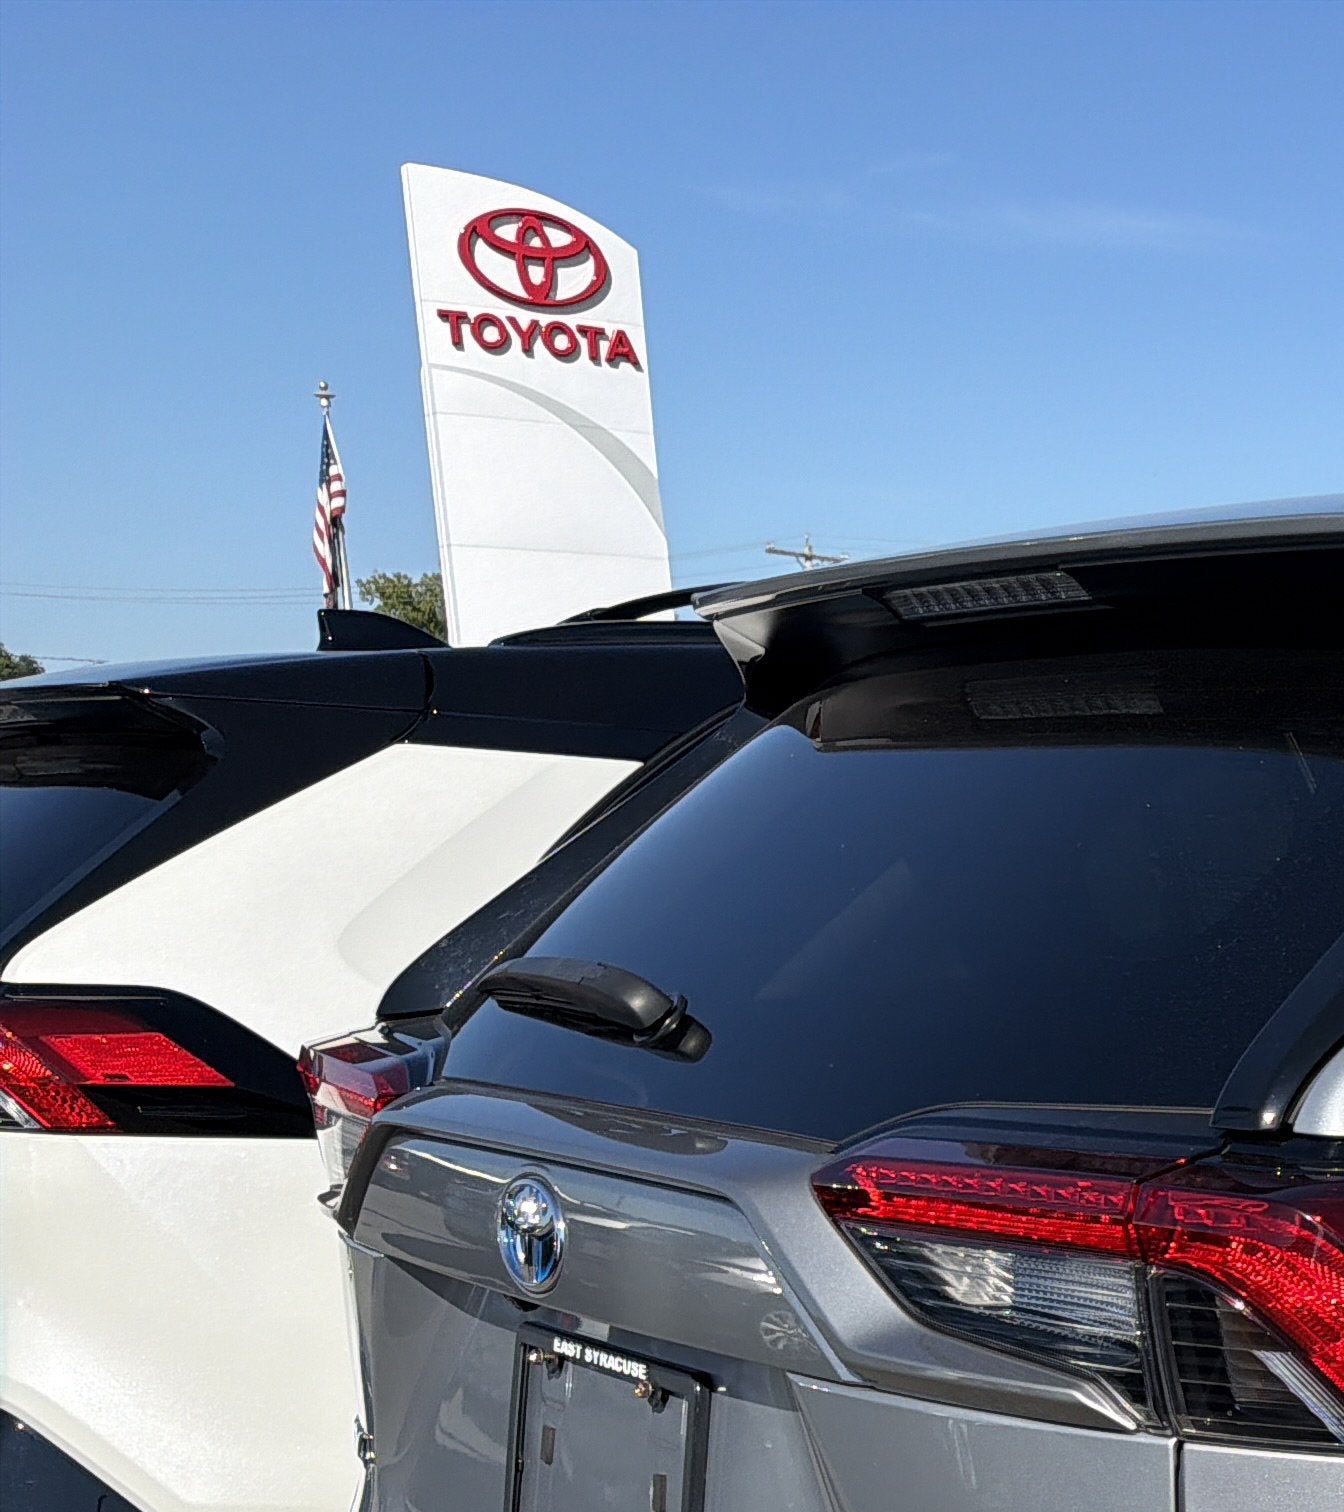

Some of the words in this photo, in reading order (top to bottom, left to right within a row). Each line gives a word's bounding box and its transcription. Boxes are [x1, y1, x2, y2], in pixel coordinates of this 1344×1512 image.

[437, 309, 641, 368] TOYOTA
[553, 1336, 582, 1359] EAST
[584, 1346, 648, 1380] SYRACUSE
